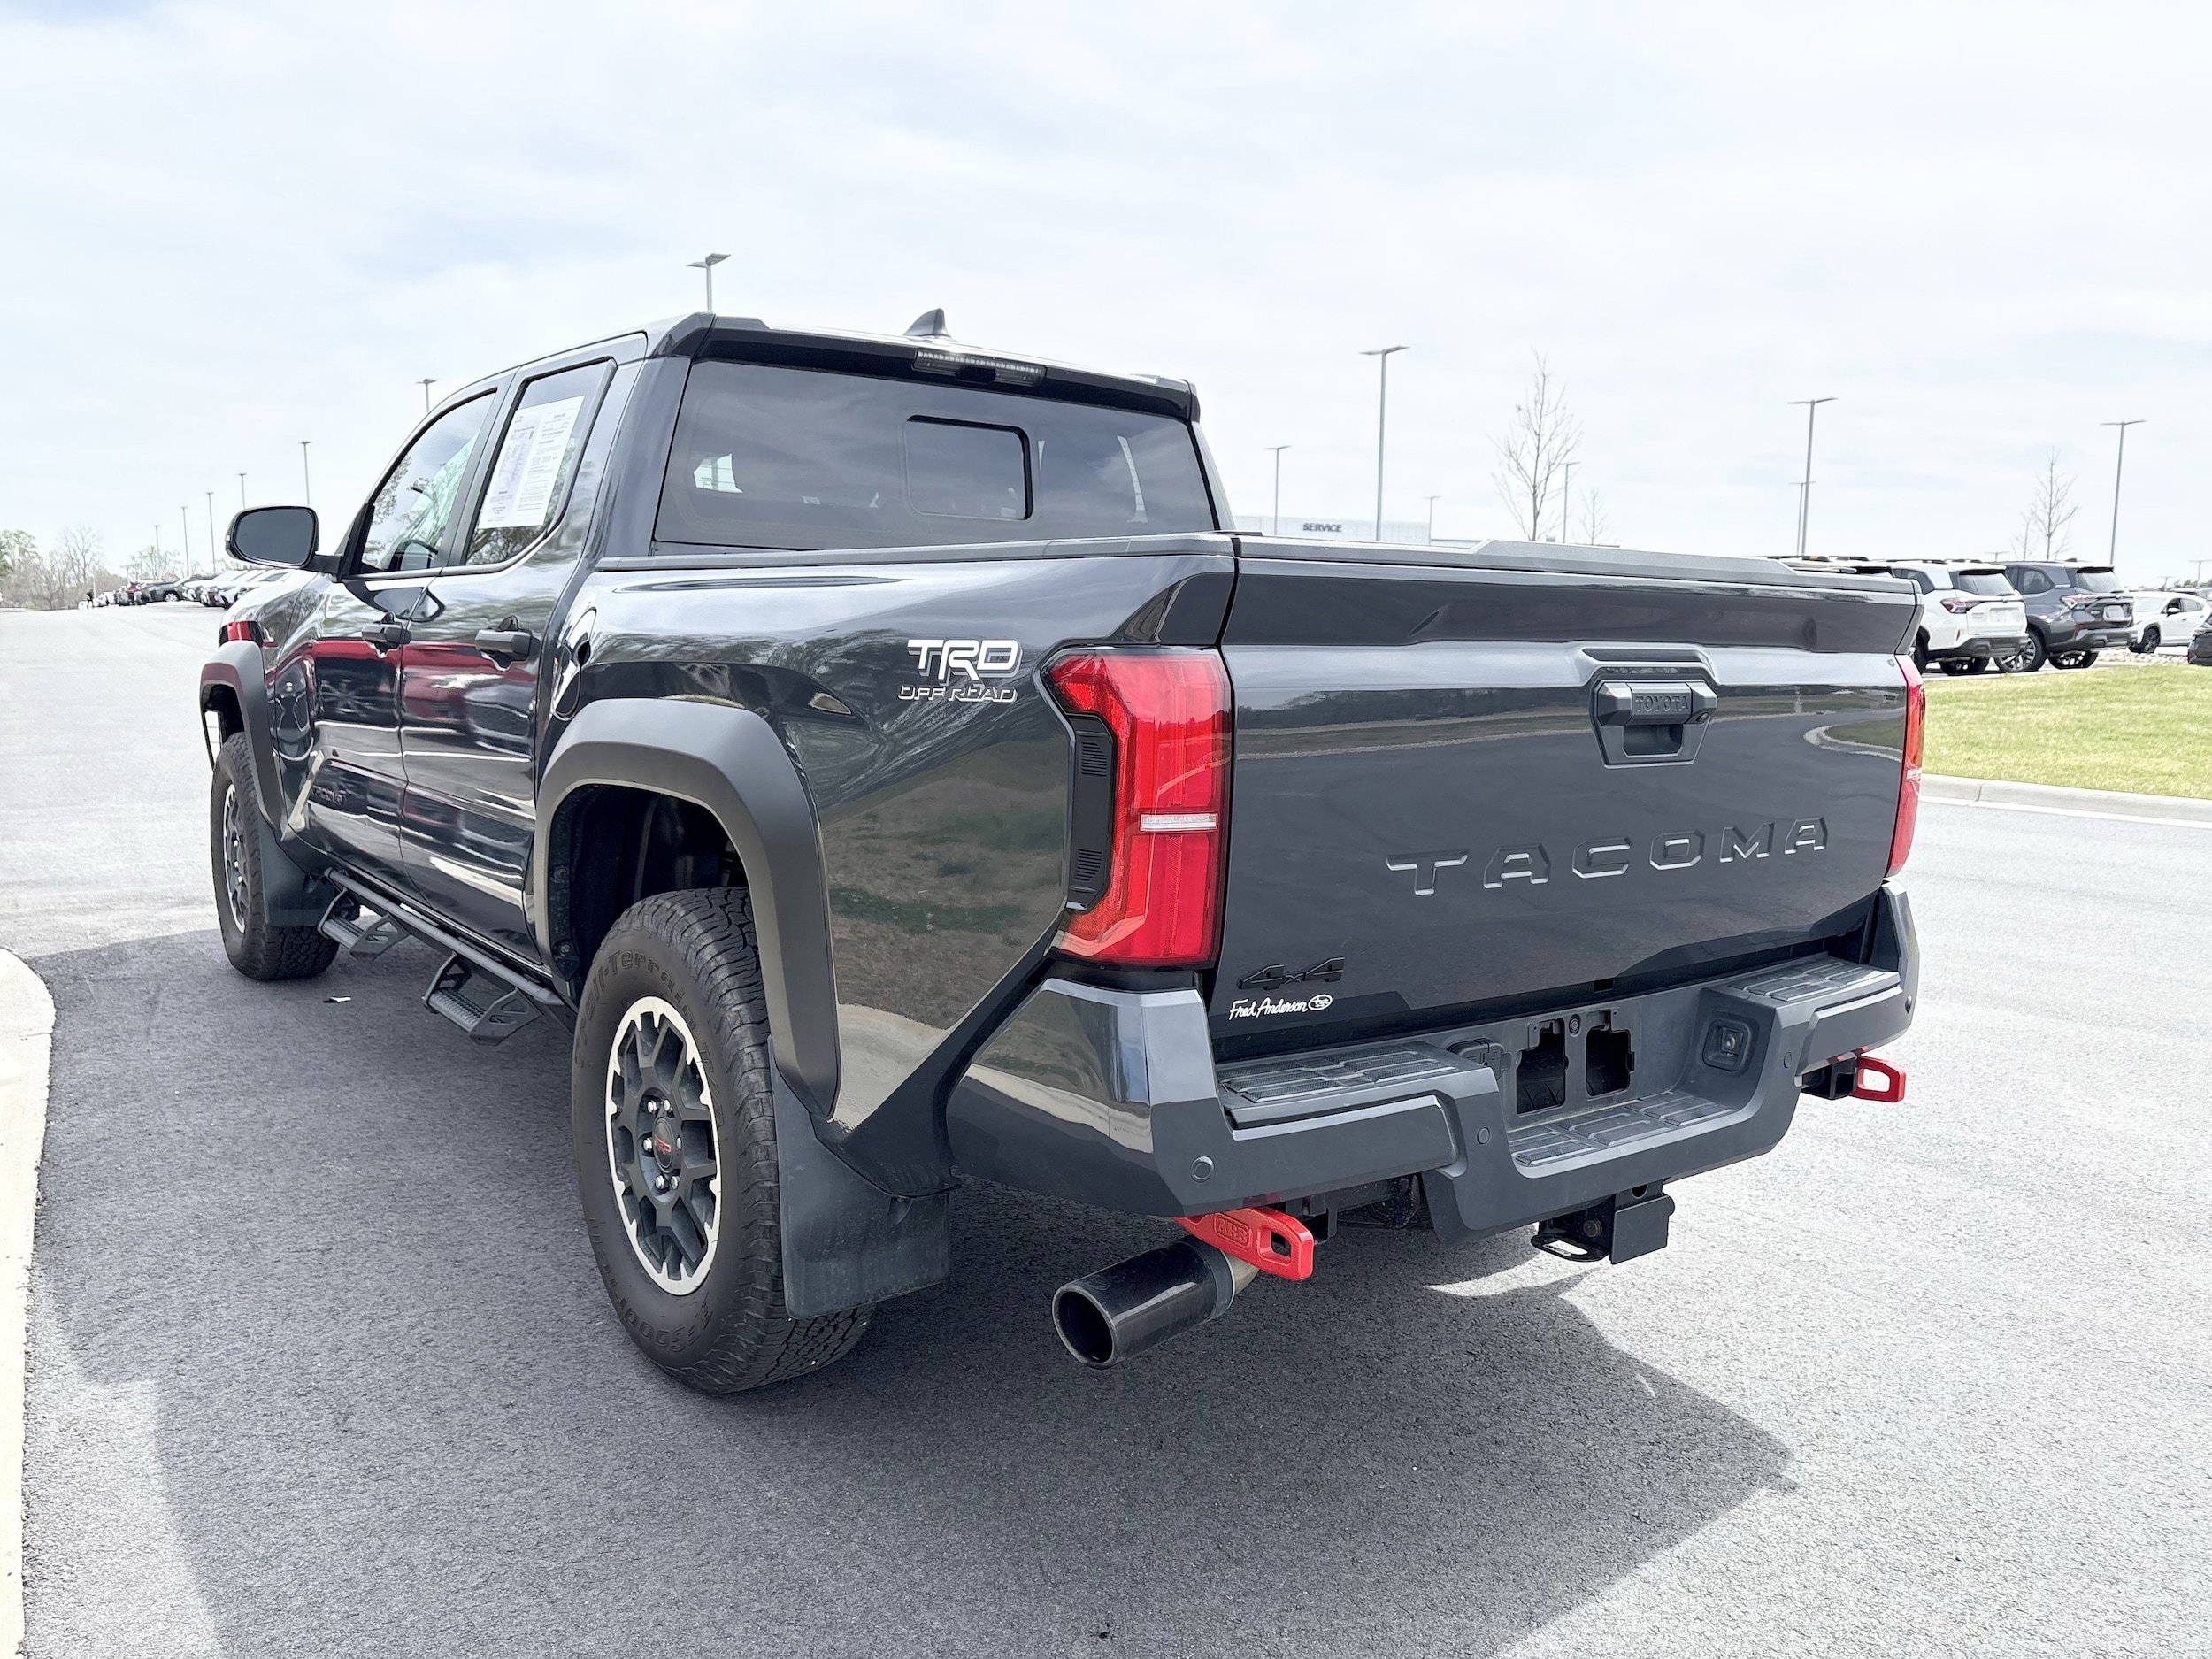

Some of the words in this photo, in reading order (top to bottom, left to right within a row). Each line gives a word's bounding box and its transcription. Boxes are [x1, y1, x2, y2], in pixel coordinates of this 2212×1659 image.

[1302, 523, 1342, 532] SERVICE
[907, 639, 1022, 681] TRD
[898, 685, 946, 701] OFF
[949, 686, 1018, 703] ROAD
[1635, 695, 1689, 712] TOYOTA
[1386, 816, 1828, 895] TACOMA
[1228, 998, 1257, 1020] Fred
[1256, 996, 1309, 1018] Anderson
